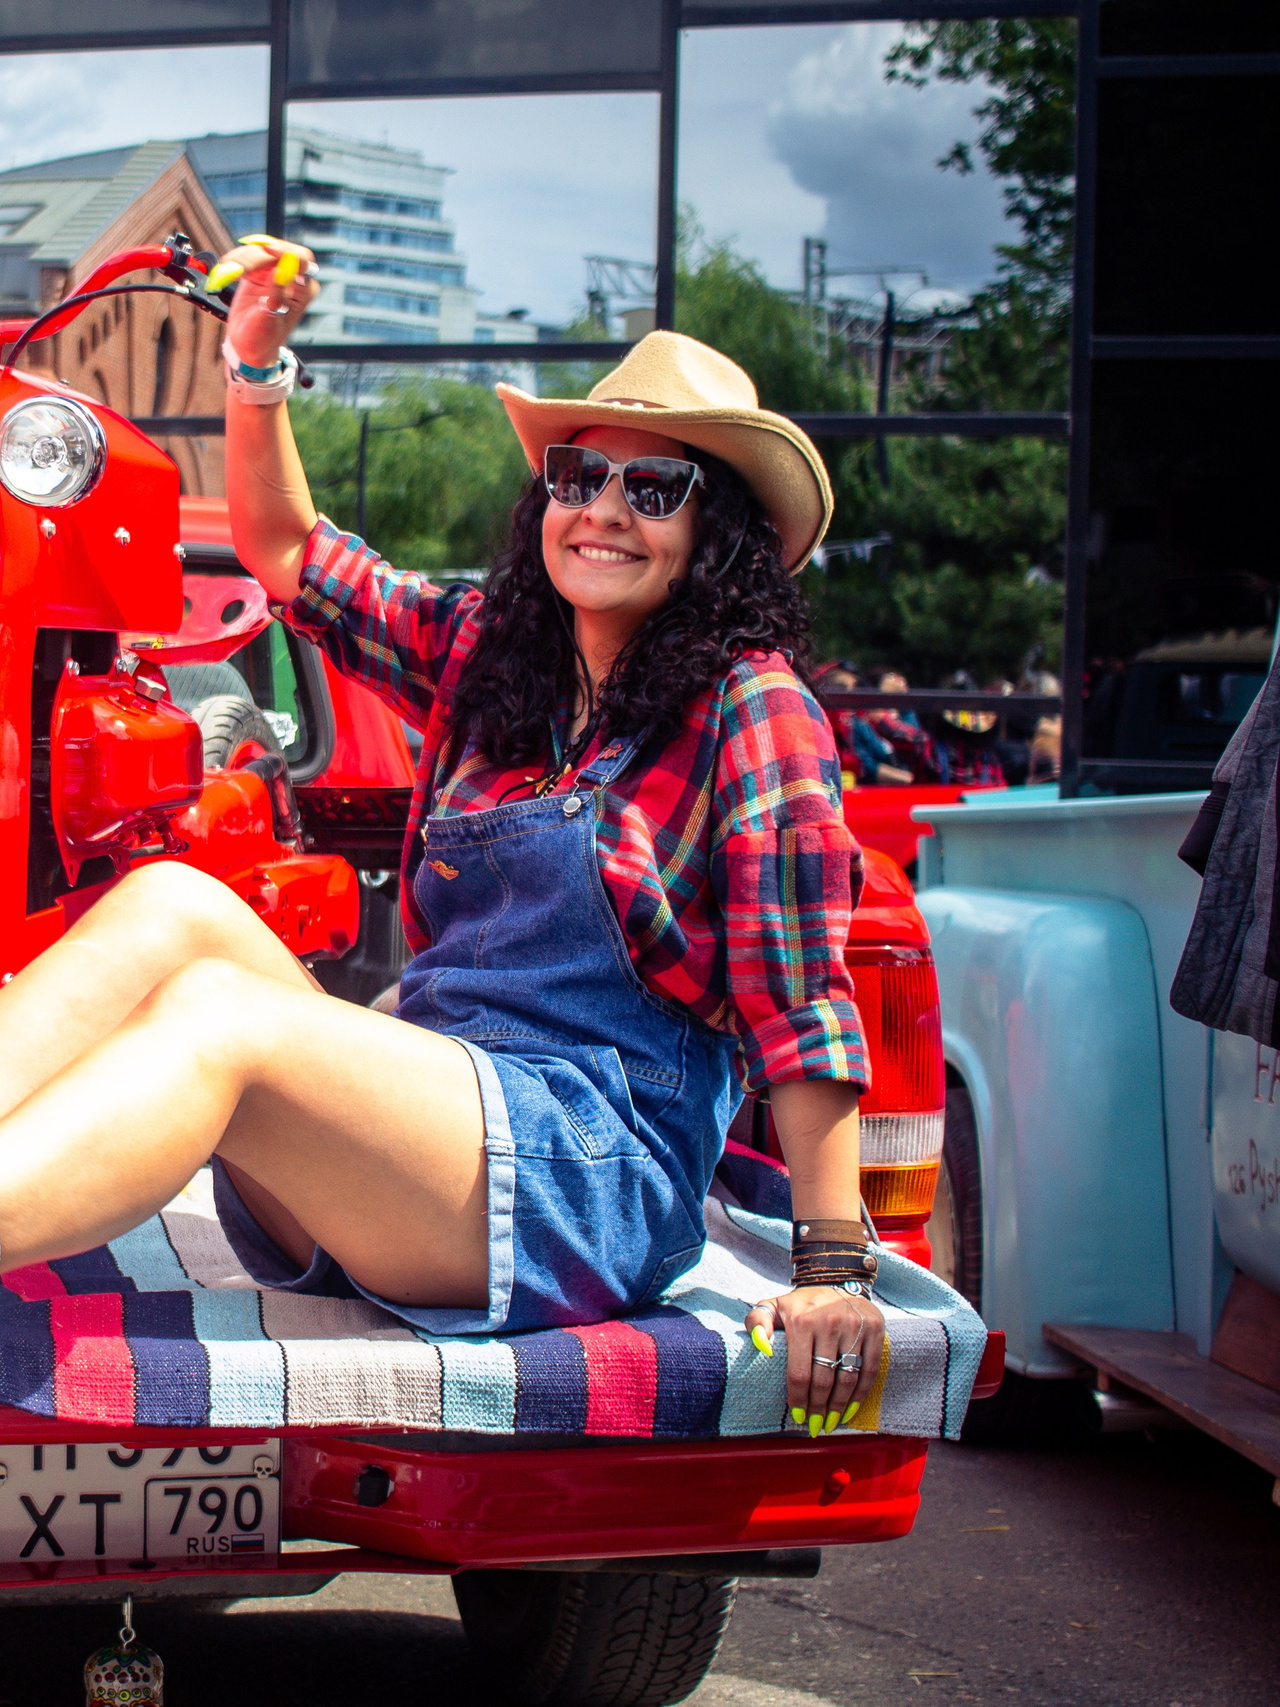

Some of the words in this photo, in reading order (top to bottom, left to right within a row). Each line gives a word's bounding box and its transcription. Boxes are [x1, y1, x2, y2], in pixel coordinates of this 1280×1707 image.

[19, 1493, 121, 1558] XT
[163, 1484, 263, 1535] 790
[186, 1536, 231, 1554] RUS
